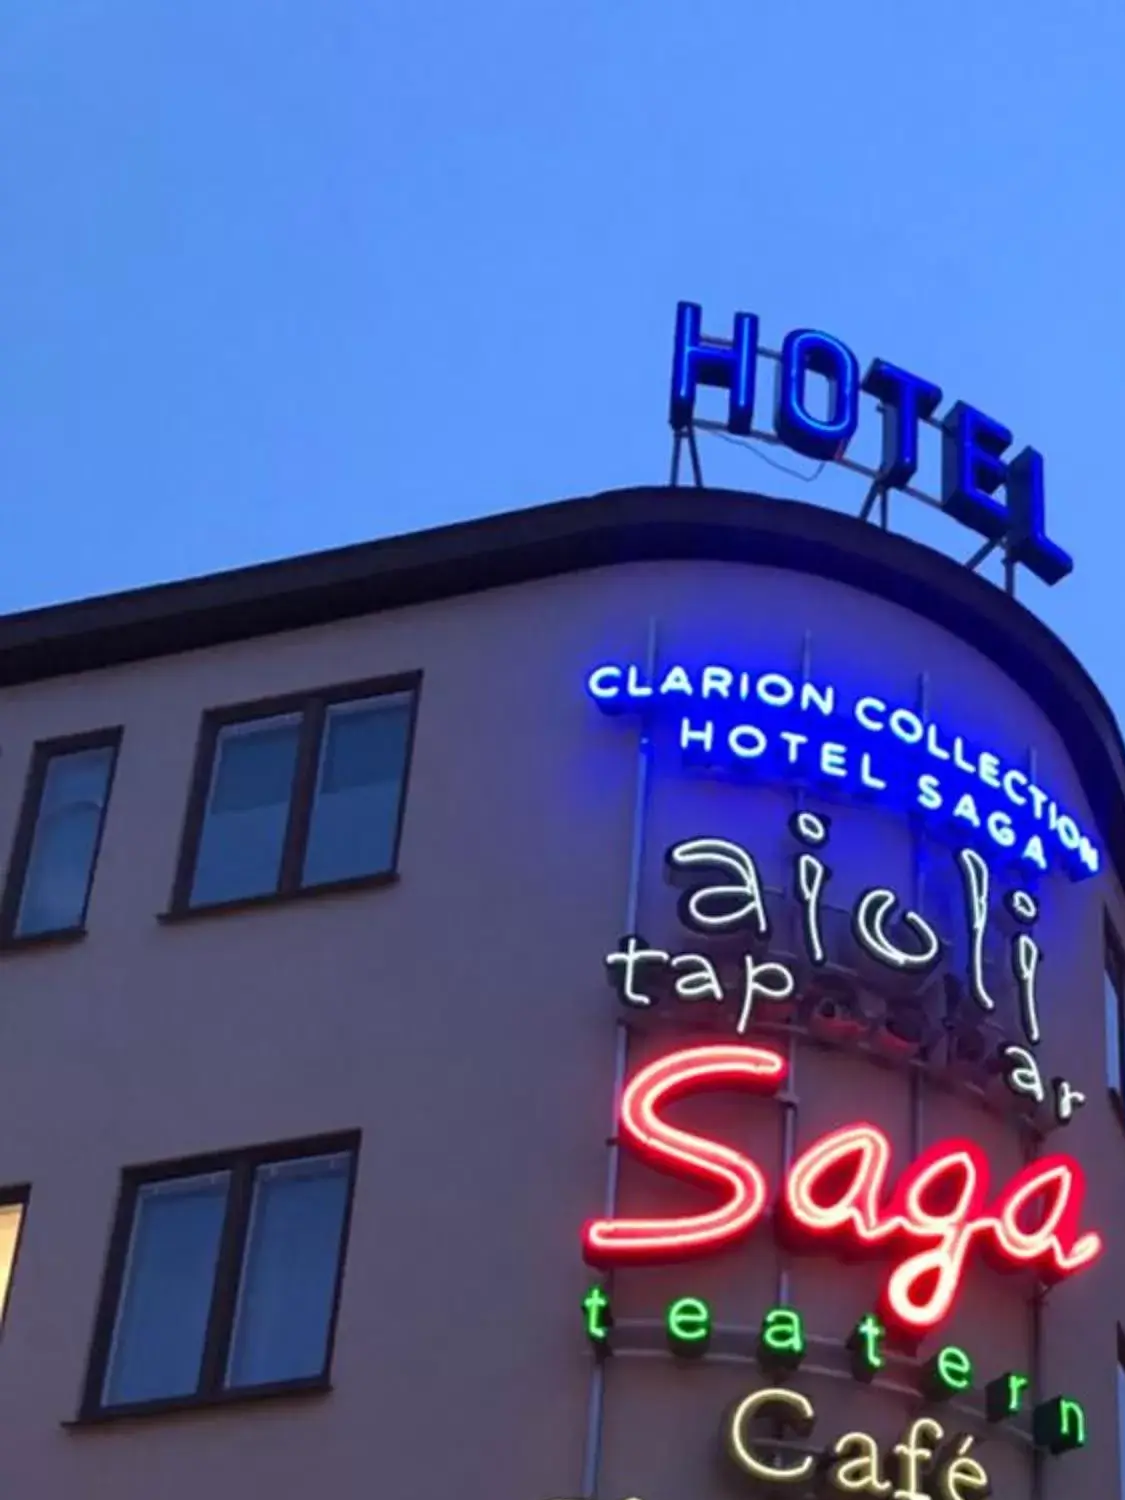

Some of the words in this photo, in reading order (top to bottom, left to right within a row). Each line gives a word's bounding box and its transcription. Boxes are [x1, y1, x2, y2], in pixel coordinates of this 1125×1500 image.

[668, 301, 1074, 586] HOTEL
[588, 664, 836, 716] CLARION
[854, 694, 1102, 874] COLLECTION
[679, 717, 887, 790] HOTEL
[915, 772, 1050, 871] SAGA
[671, 811, 1042, 1042] aioli
[586, 1044, 1104, 1328] Saga
[583, 1287, 1087, 1446] teatern
